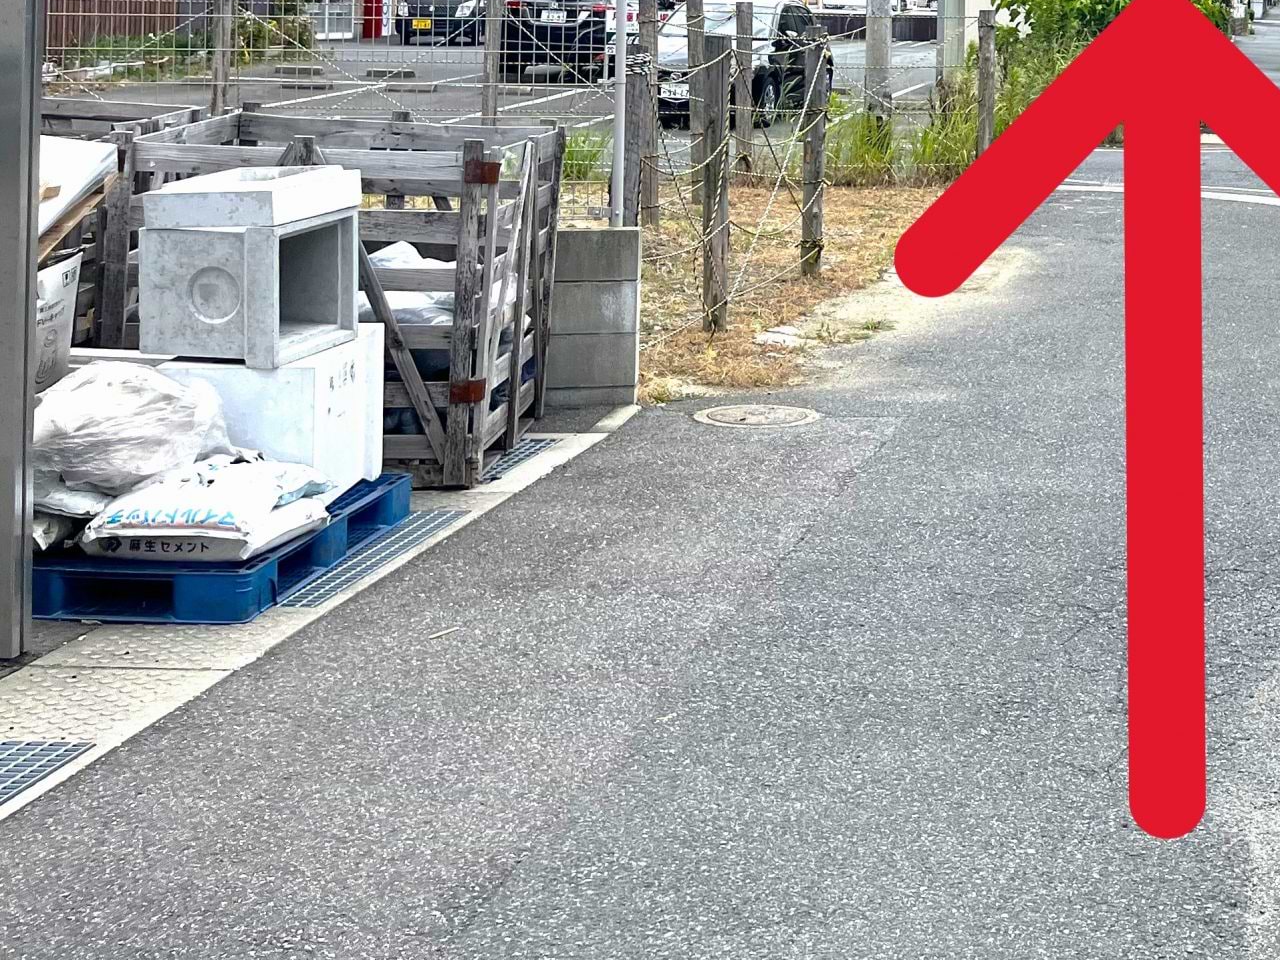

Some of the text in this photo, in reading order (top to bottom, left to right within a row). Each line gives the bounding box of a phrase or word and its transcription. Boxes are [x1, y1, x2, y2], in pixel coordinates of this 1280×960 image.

[128, 540, 210, 553] 麻生セメント
